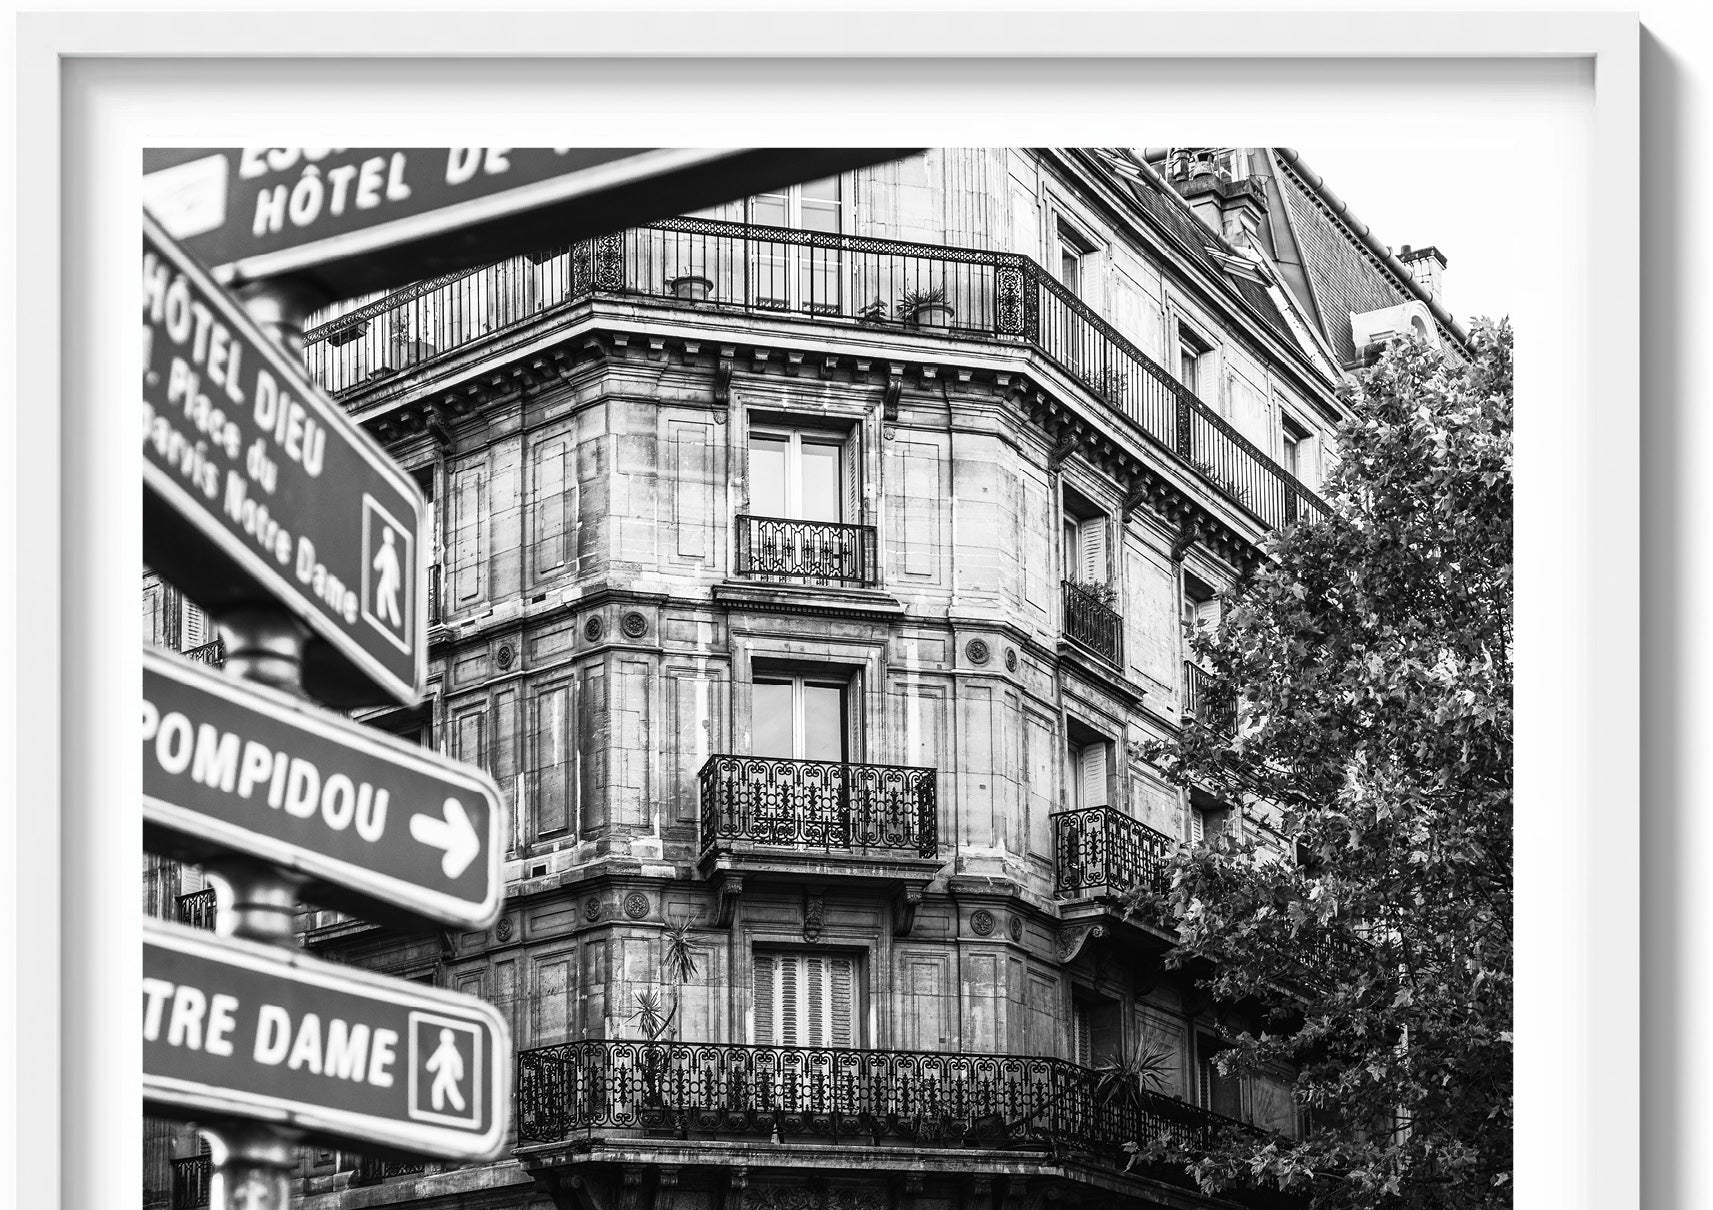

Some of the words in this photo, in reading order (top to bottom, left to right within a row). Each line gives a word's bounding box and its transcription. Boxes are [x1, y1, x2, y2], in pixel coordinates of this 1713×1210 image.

[252, 151, 412, 237] HÔTEL
[143, 252, 246, 403] HÔTEL
[253, 368, 327, 478] DIEU
[167, 354, 242, 460] Place
[246, 437, 279, 494] du
[223, 469, 293, 567] Notre
[295, 535, 359, 626] Dame
[253, 1004, 399, 1087] DAME
